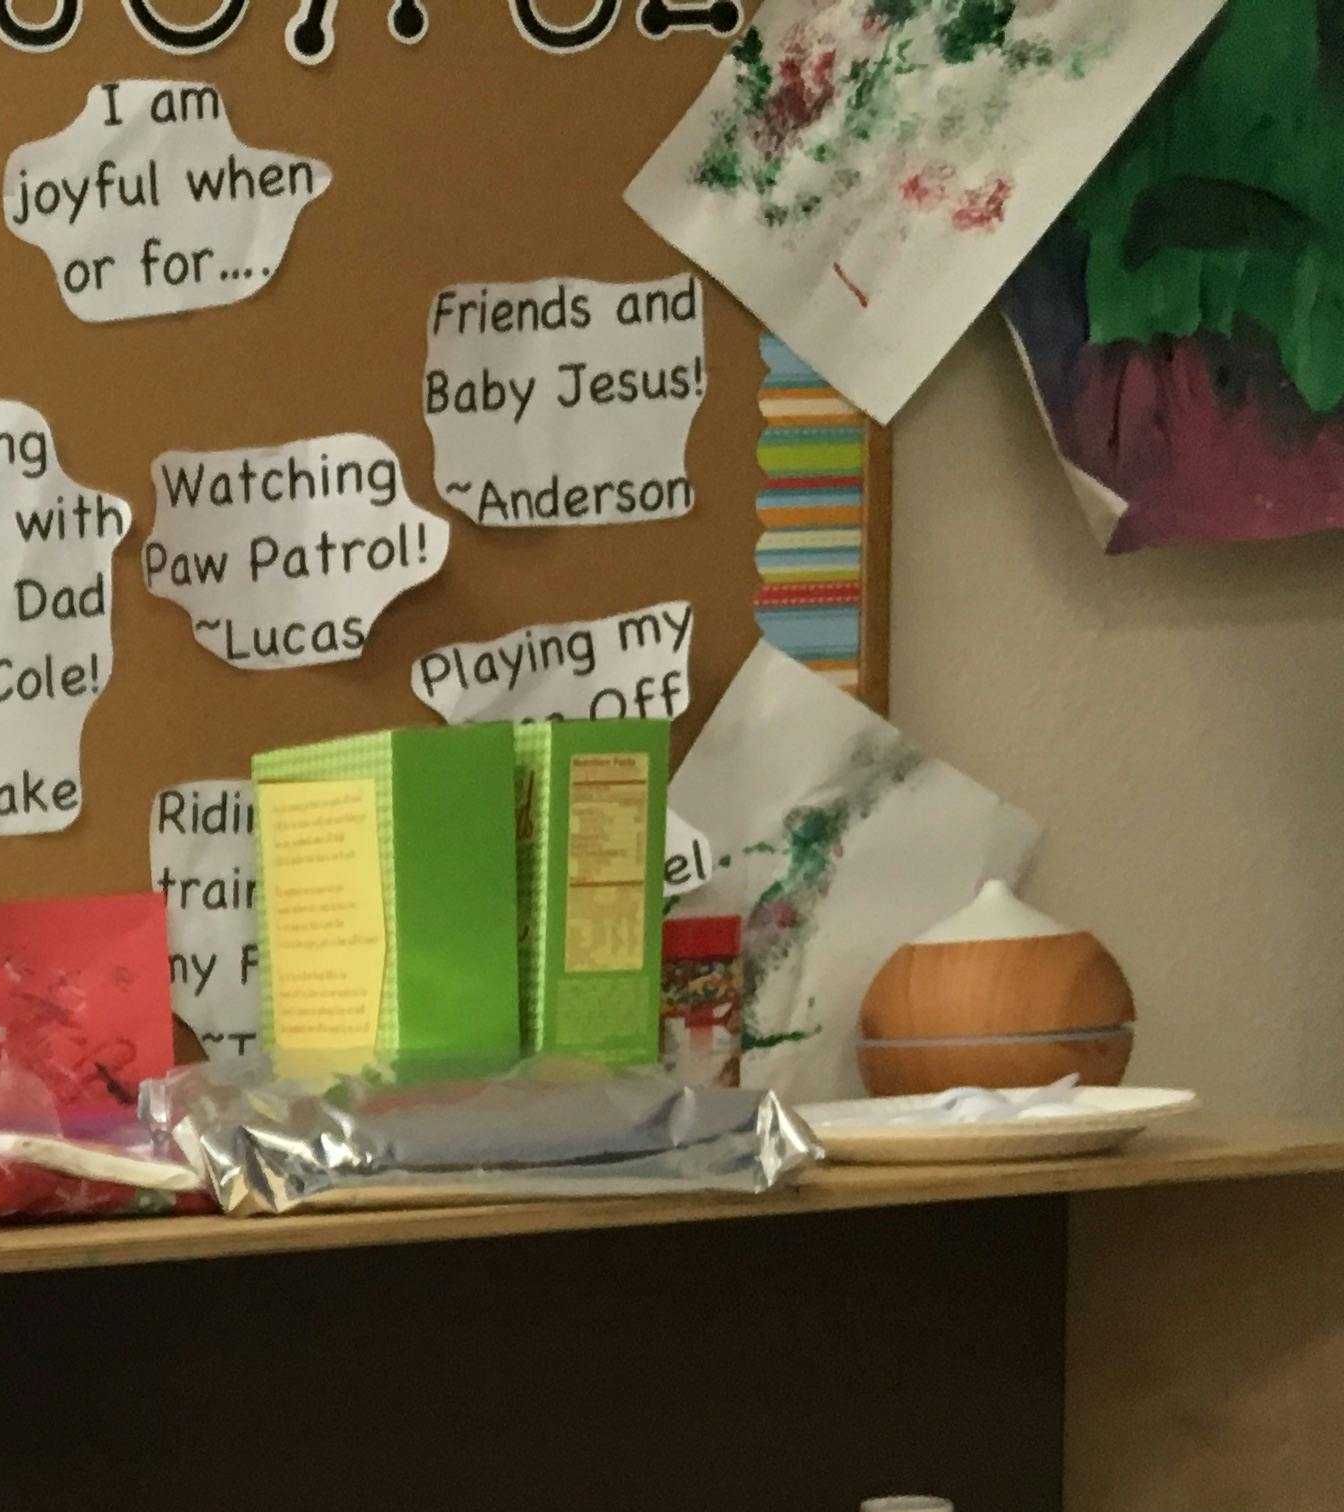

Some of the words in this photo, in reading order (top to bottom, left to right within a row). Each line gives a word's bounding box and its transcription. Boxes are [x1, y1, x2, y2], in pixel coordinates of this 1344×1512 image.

[101, 82, 123, 126] I
[150, 86, 219, 124] am
[12, 159, 159, 225] joyful
[186, 153, 314, 203] when
[63, 255, 116, 294] or
[432, 284, 591, 336] Friends
[615, 277, 697, 325] and
[424, 367, 536, 423] Baby
[557, 356, 705, 409] Jesus!
[161, 457, 396, 508] Watching
[445, 475, 693, 522] ~Anderson
[16, 495, 124, 544] with
[145, 544, 228, 588] Paw
[249, 524, 429, 582] Patrol!
[14, 572, 105, 622] Dad
[197, 614, 366, 661] ~Lucas
[419, 630, 597, 698] Playing
[618, 605, 692, 654] my
[663, 838, 706, 881] el
